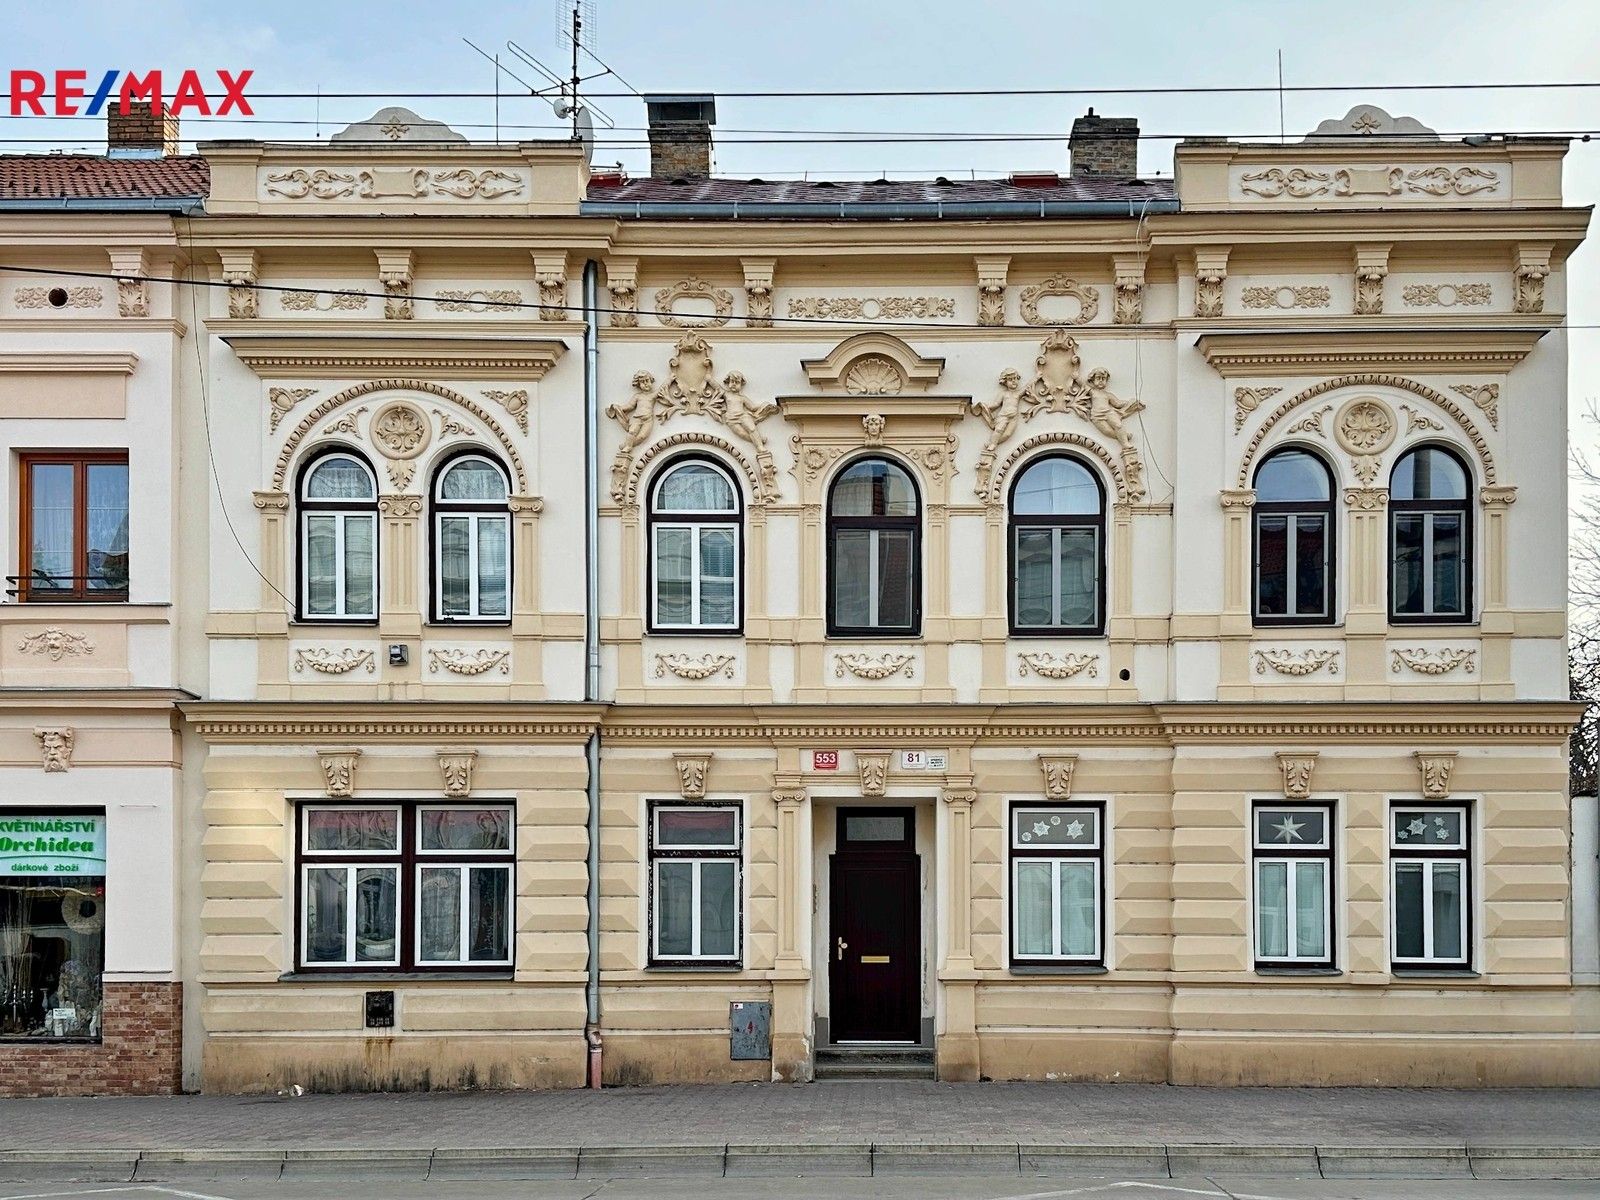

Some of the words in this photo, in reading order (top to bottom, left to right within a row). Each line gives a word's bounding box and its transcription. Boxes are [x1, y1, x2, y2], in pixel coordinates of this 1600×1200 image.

[816, 753, 836, 763] 553
[907, 753, 920, 762] 81
[0, 837, 94, 852] Orchidea
[11, 863, 48, 872] dárkové
[53, 863, 79, 872] zboží
